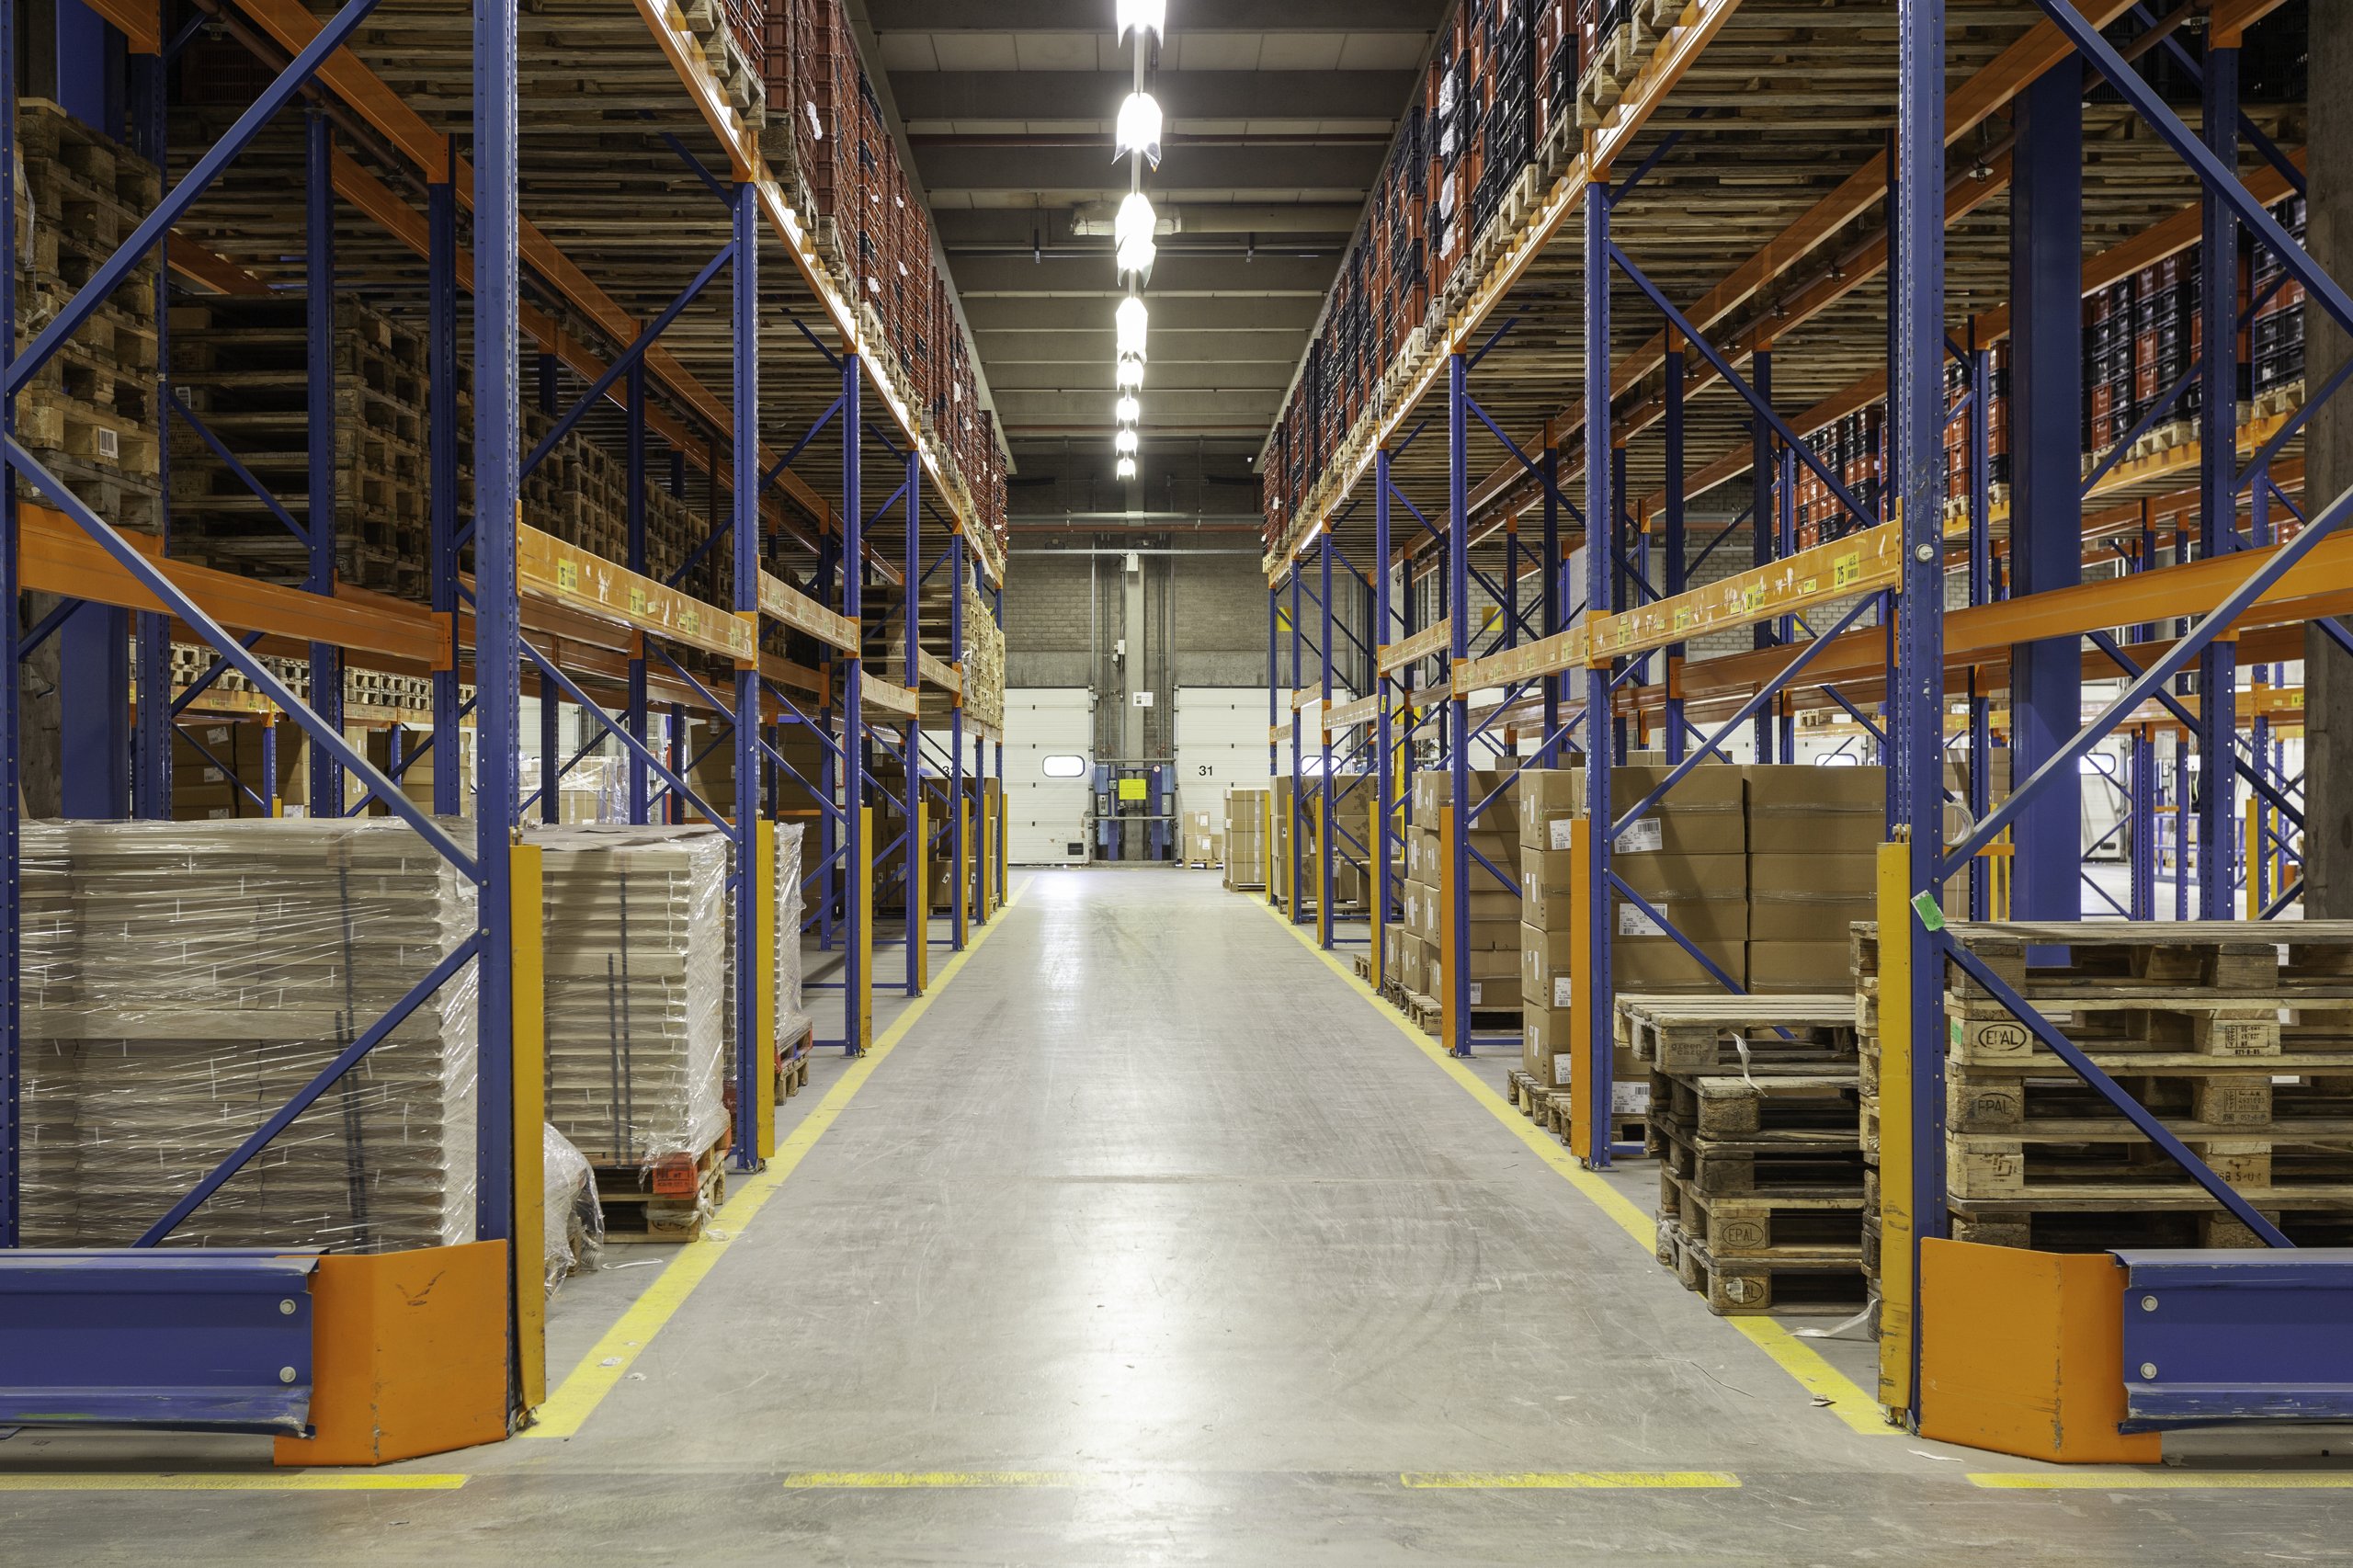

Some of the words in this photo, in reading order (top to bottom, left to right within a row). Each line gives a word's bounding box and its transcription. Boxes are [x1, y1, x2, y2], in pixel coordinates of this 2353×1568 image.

[1199, 766, 1213, 776] 31
[1986, 1029, 2018, 1045] EPAL
[1728, 1228, 1757, 1242] EPAL
